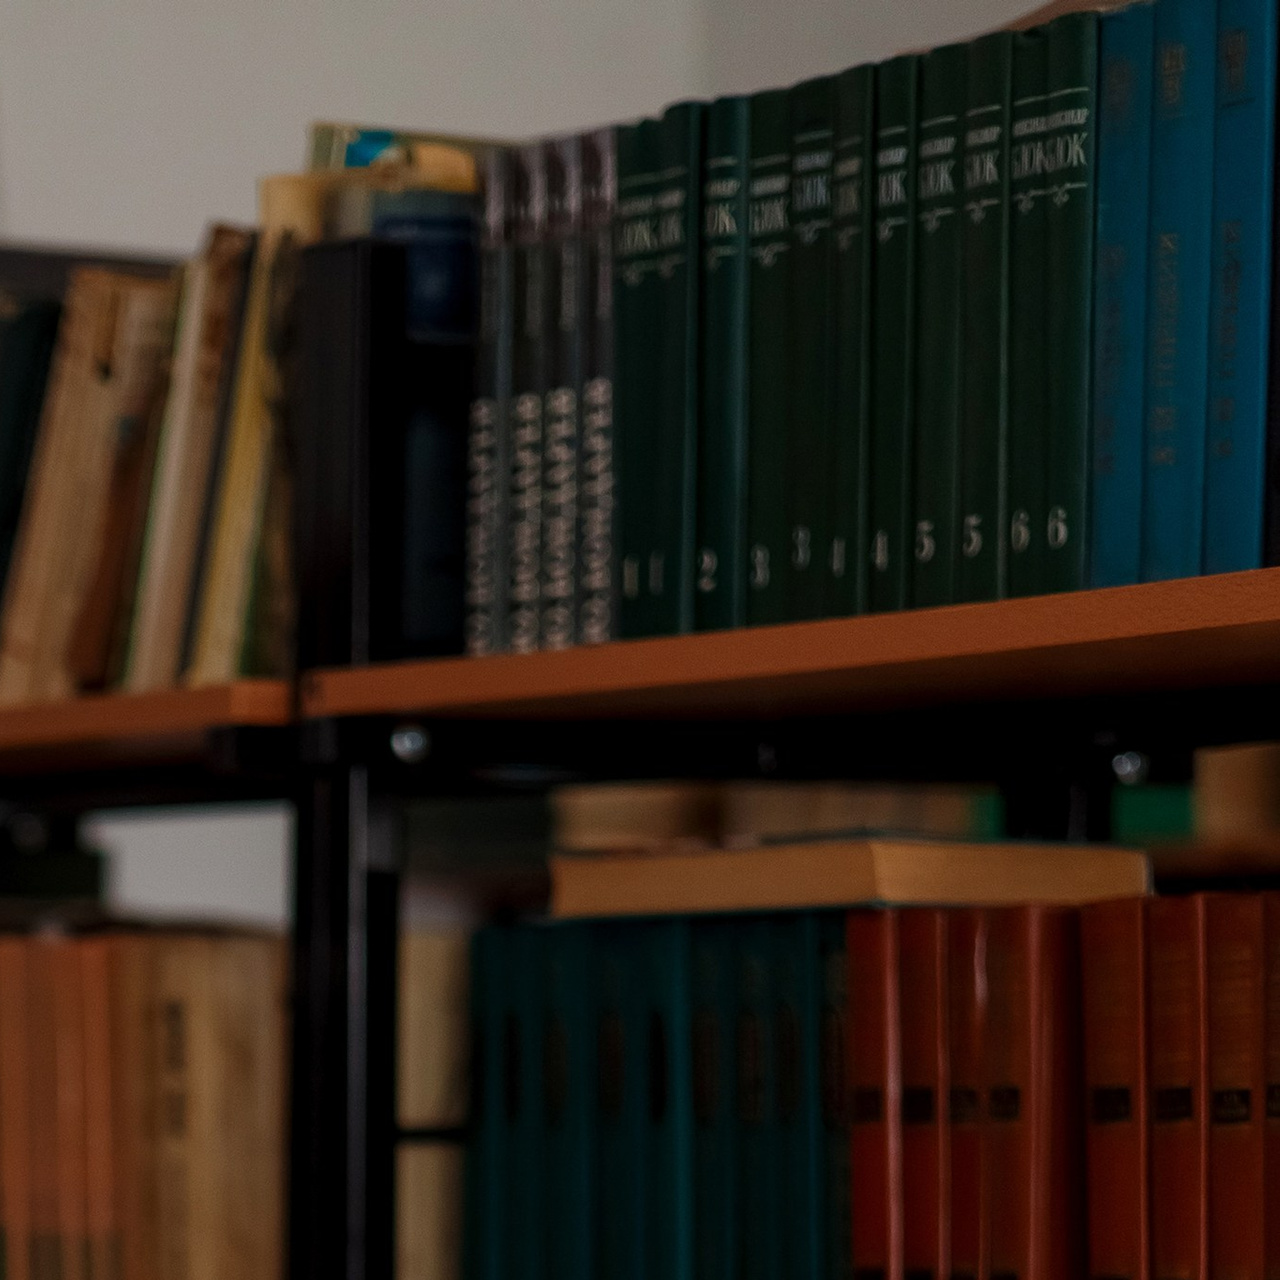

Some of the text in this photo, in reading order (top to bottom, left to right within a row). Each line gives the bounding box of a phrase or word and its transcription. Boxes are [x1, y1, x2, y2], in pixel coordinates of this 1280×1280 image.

[915, 519, 935, 562] 5
[963, 513, 982, 557] 5
[1011, 509, 1030, 553] 6
[1047, 505, 1068, 549] 6
[698, 546, 718, 592] 2
